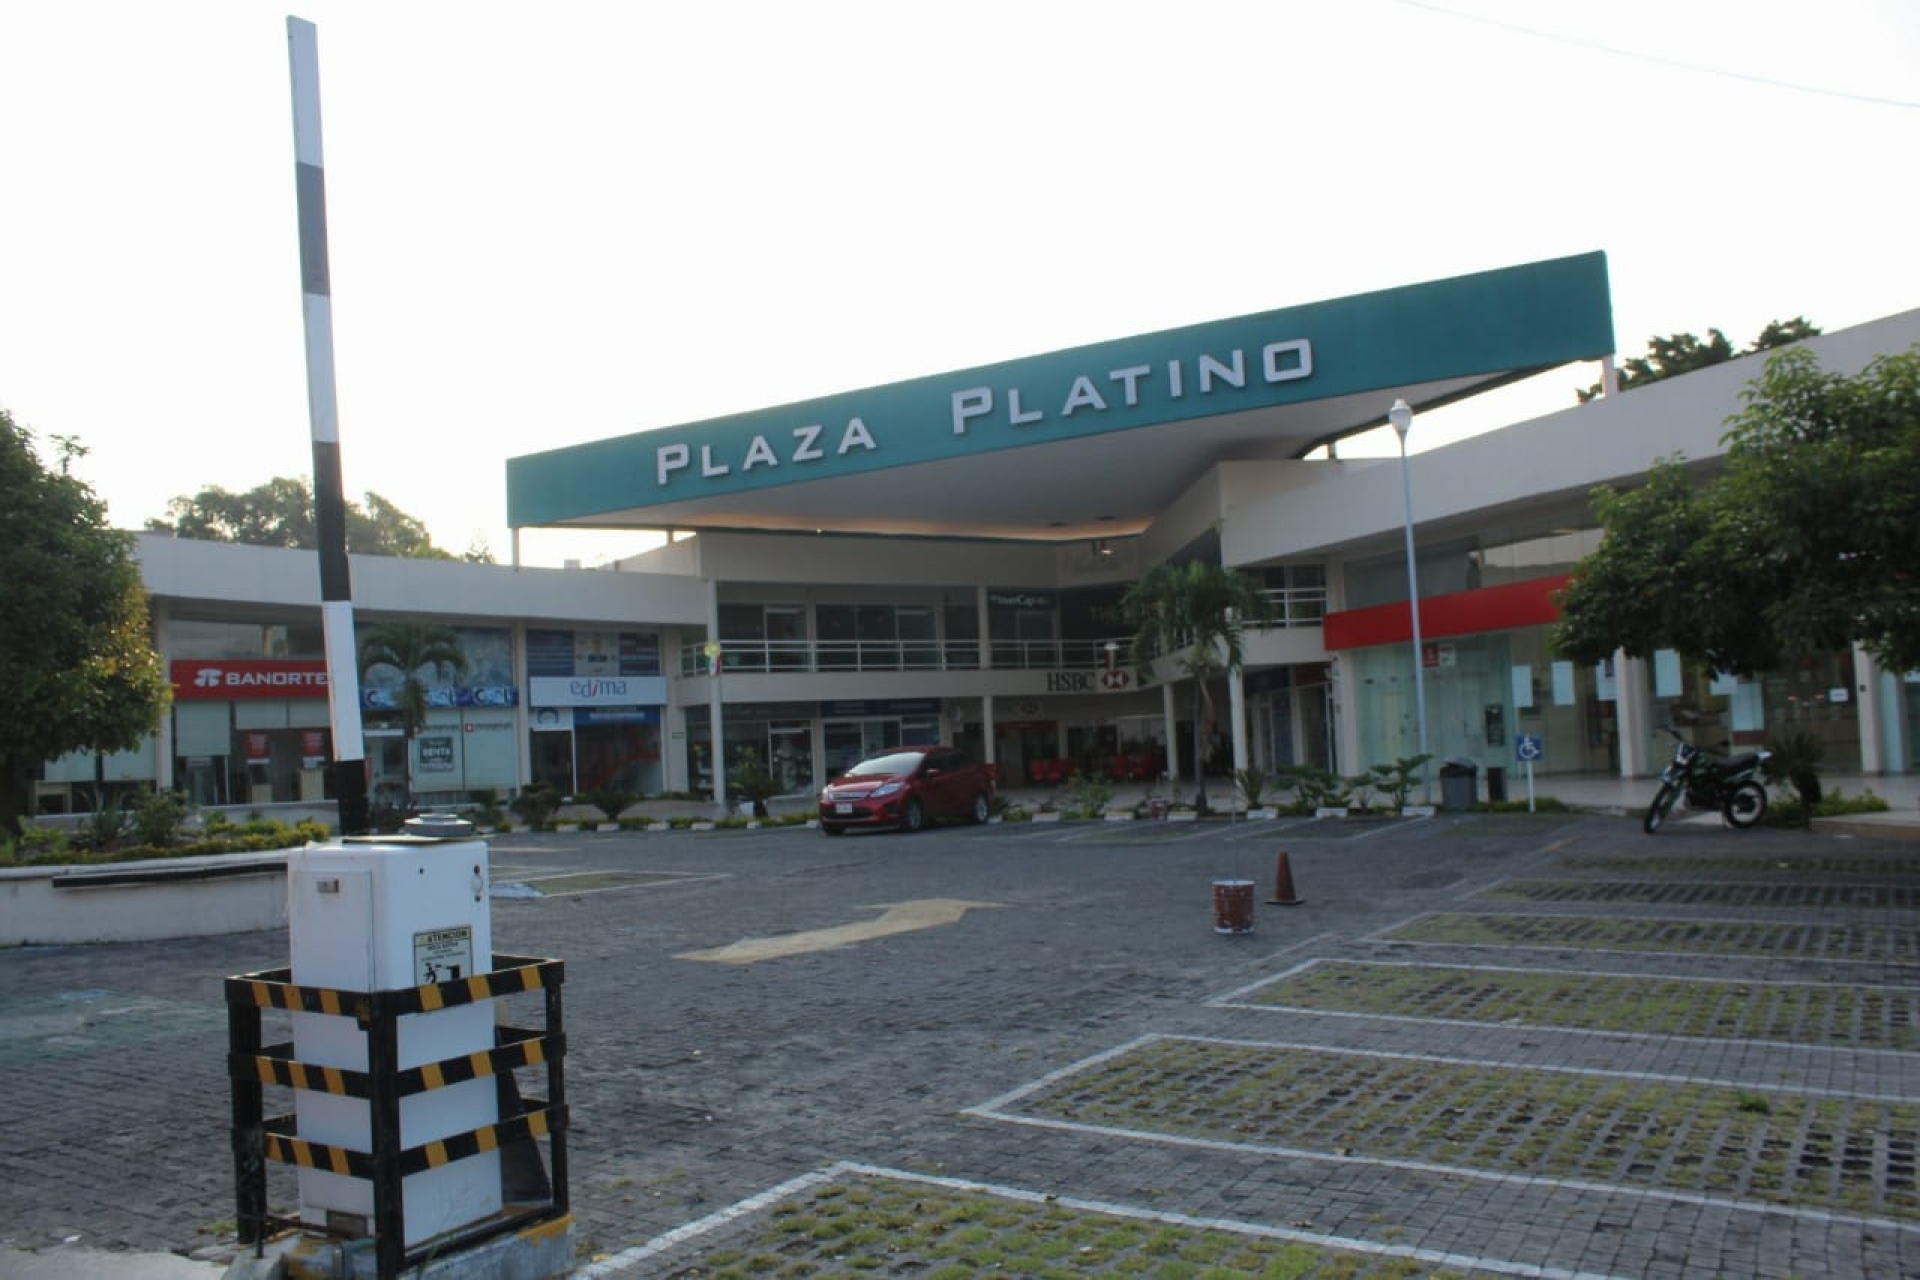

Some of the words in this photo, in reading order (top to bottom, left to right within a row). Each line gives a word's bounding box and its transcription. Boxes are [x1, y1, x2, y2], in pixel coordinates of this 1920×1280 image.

[656, 416, 877, 486] PLAZA
[951, 337, 1314, 436] PLATINO
[225, 671, 329, 686] BANORTE
[570, 678, 628, 698] edima
[1046, 671, 1097, 692] HSBC
